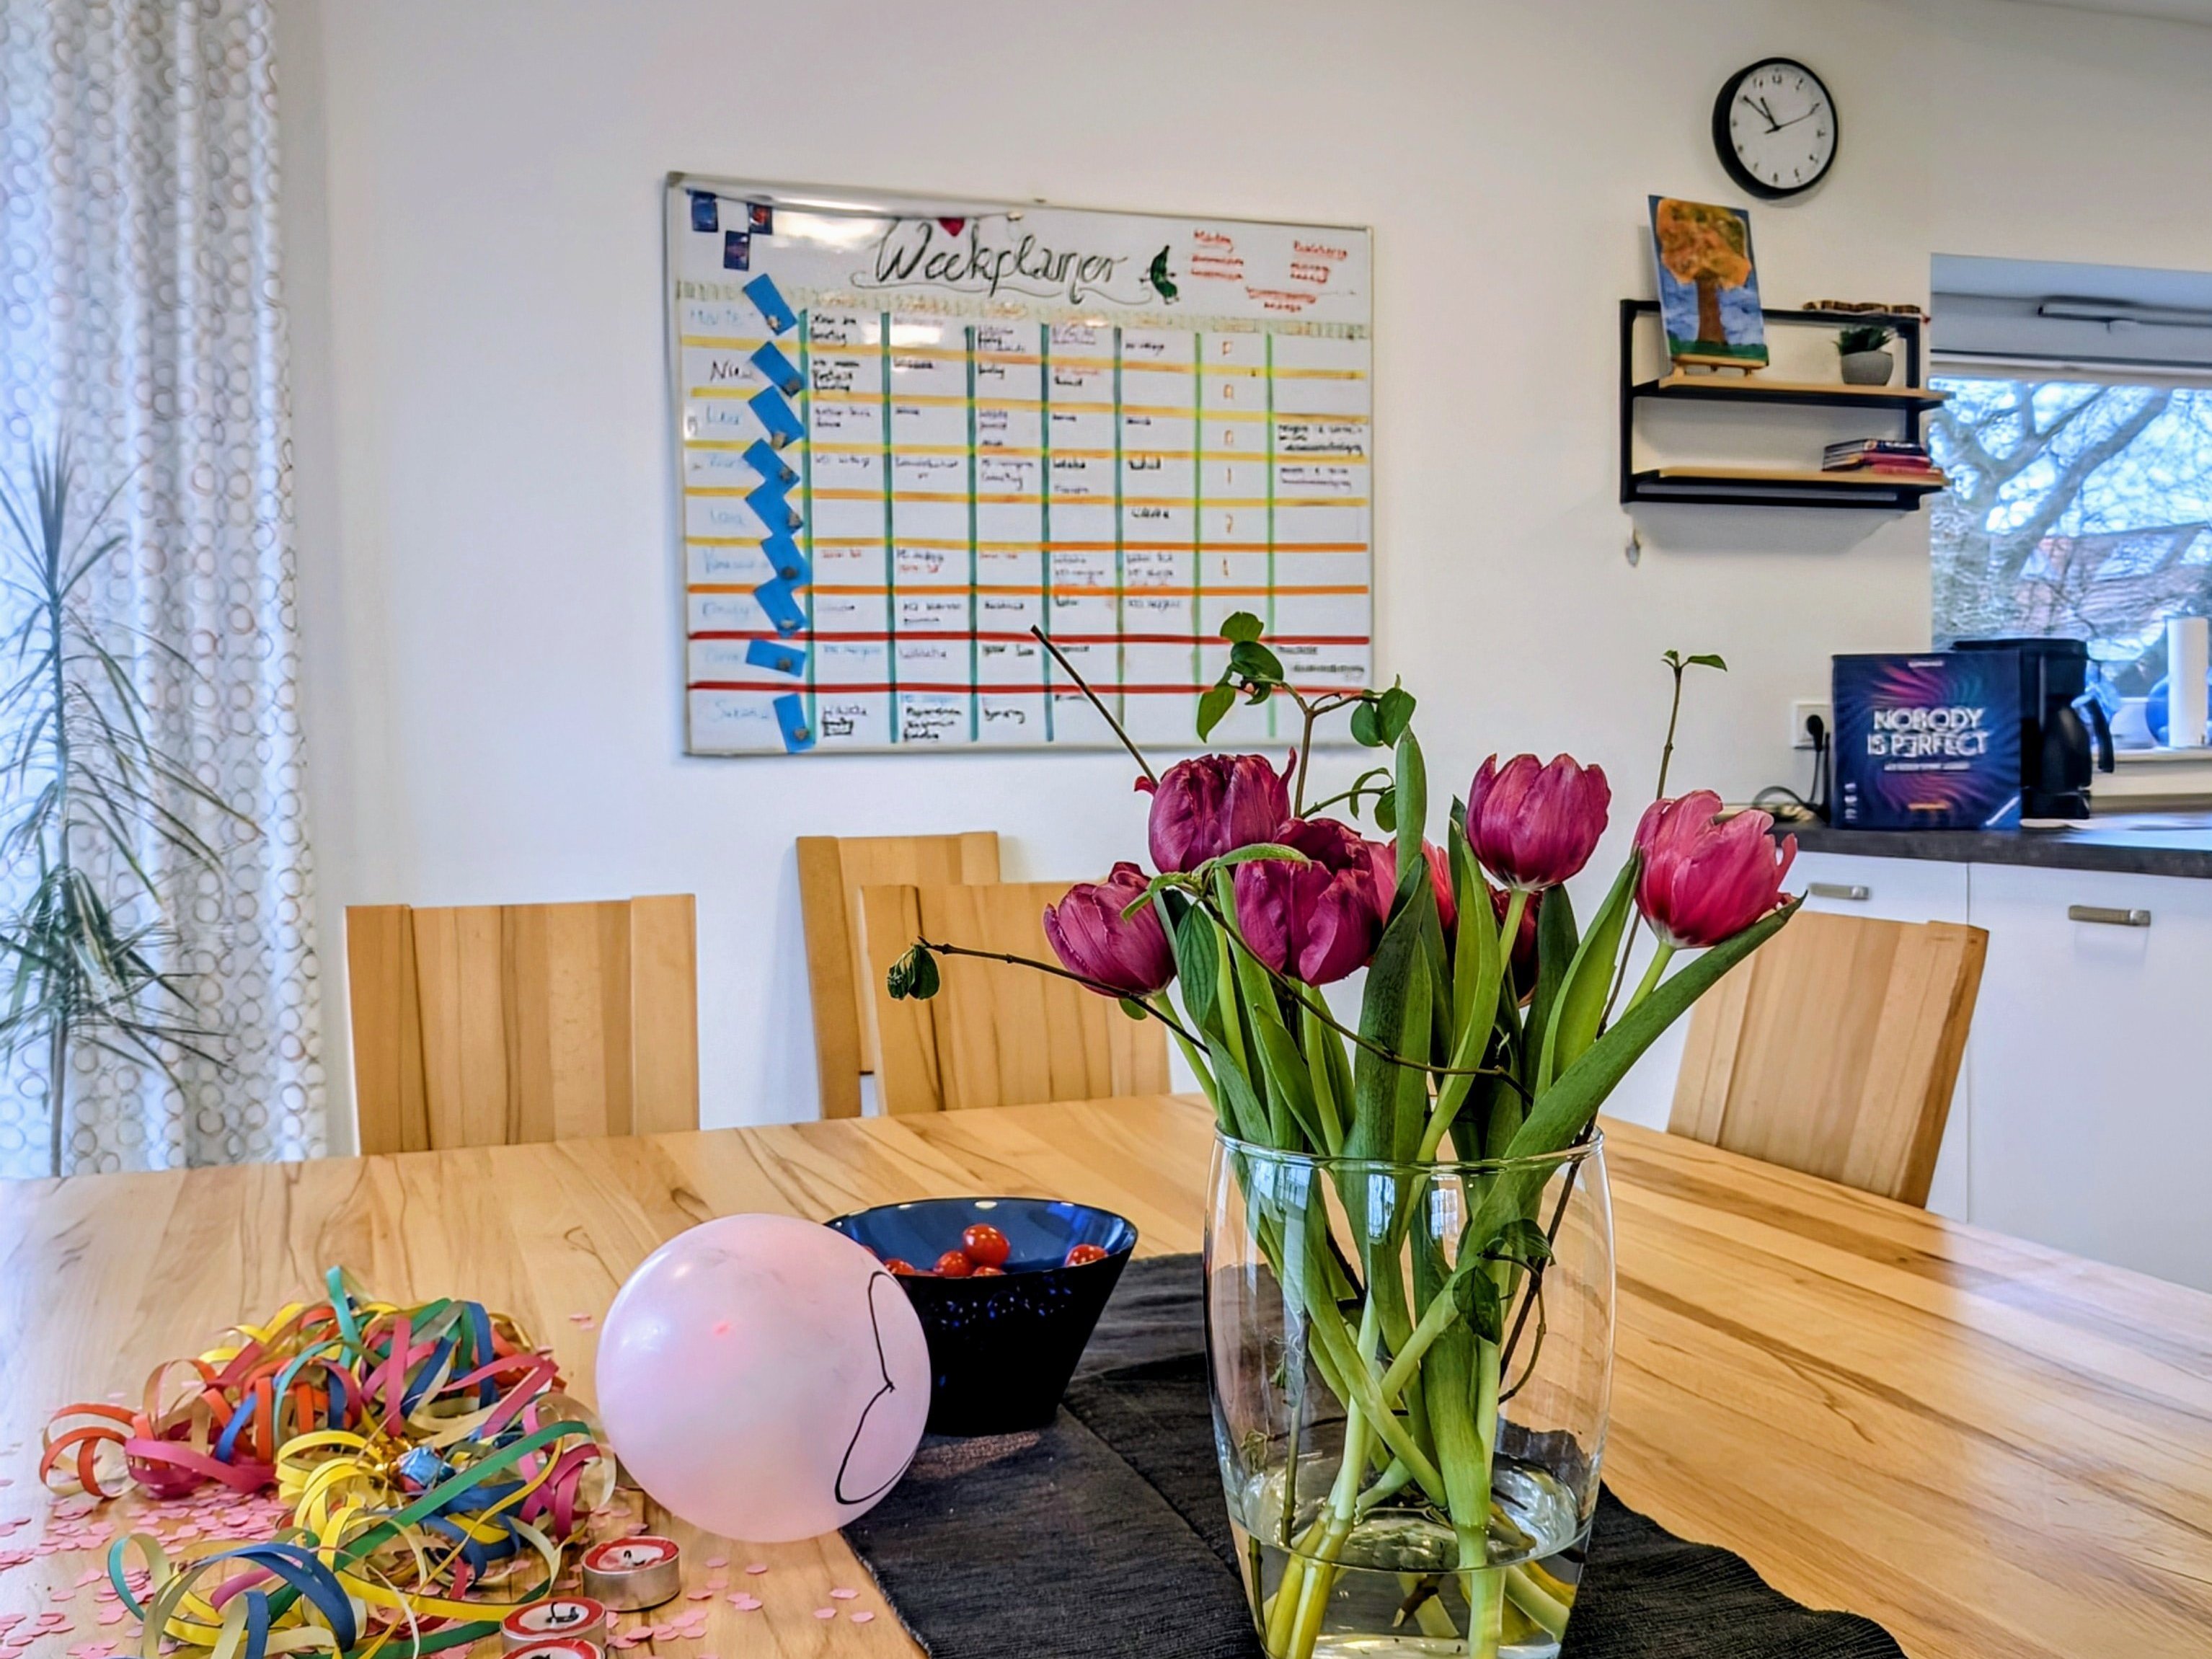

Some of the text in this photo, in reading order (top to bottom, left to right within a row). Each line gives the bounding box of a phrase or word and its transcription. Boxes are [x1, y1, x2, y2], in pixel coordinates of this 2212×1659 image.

[1874, 707, 1986, 731] NOBODY
[1867, 731, 1989, 757] IS PERFECT
